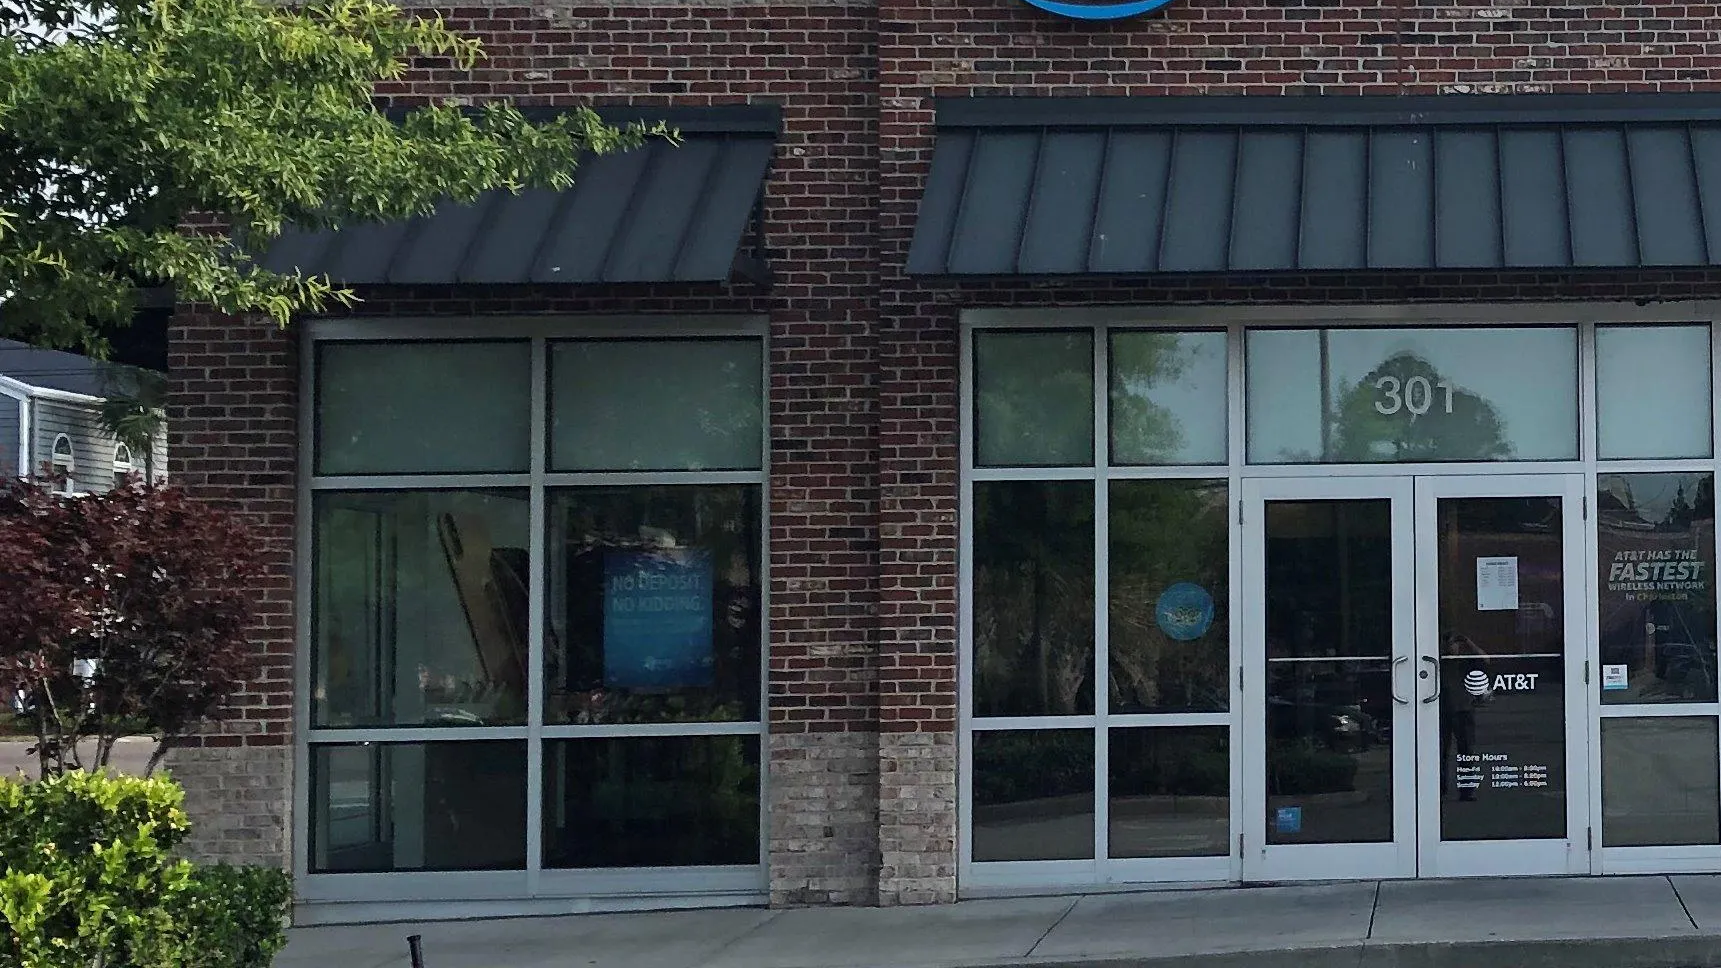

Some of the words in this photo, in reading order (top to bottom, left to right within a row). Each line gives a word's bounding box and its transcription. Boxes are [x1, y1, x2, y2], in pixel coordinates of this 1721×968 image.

[1375, 376, 1453, 415] 301
[1614, 550, 1646, 562] AT&T
[1647, 550, 1672, 561] HAS
[1674, 549, 1698, 560] THE
[1609, 561, 1705, 582] FASTEST
[612, 574, 635, 592] NO
[1608, 582, 1656, 591] WIRELESS
[1656, 581, 1705, 590] NETWORK
[1492, 673, 1539, 691] AT&T
[1456, 753, 1481, 762] Store
[1482, 753, 1508, 761] Hours
